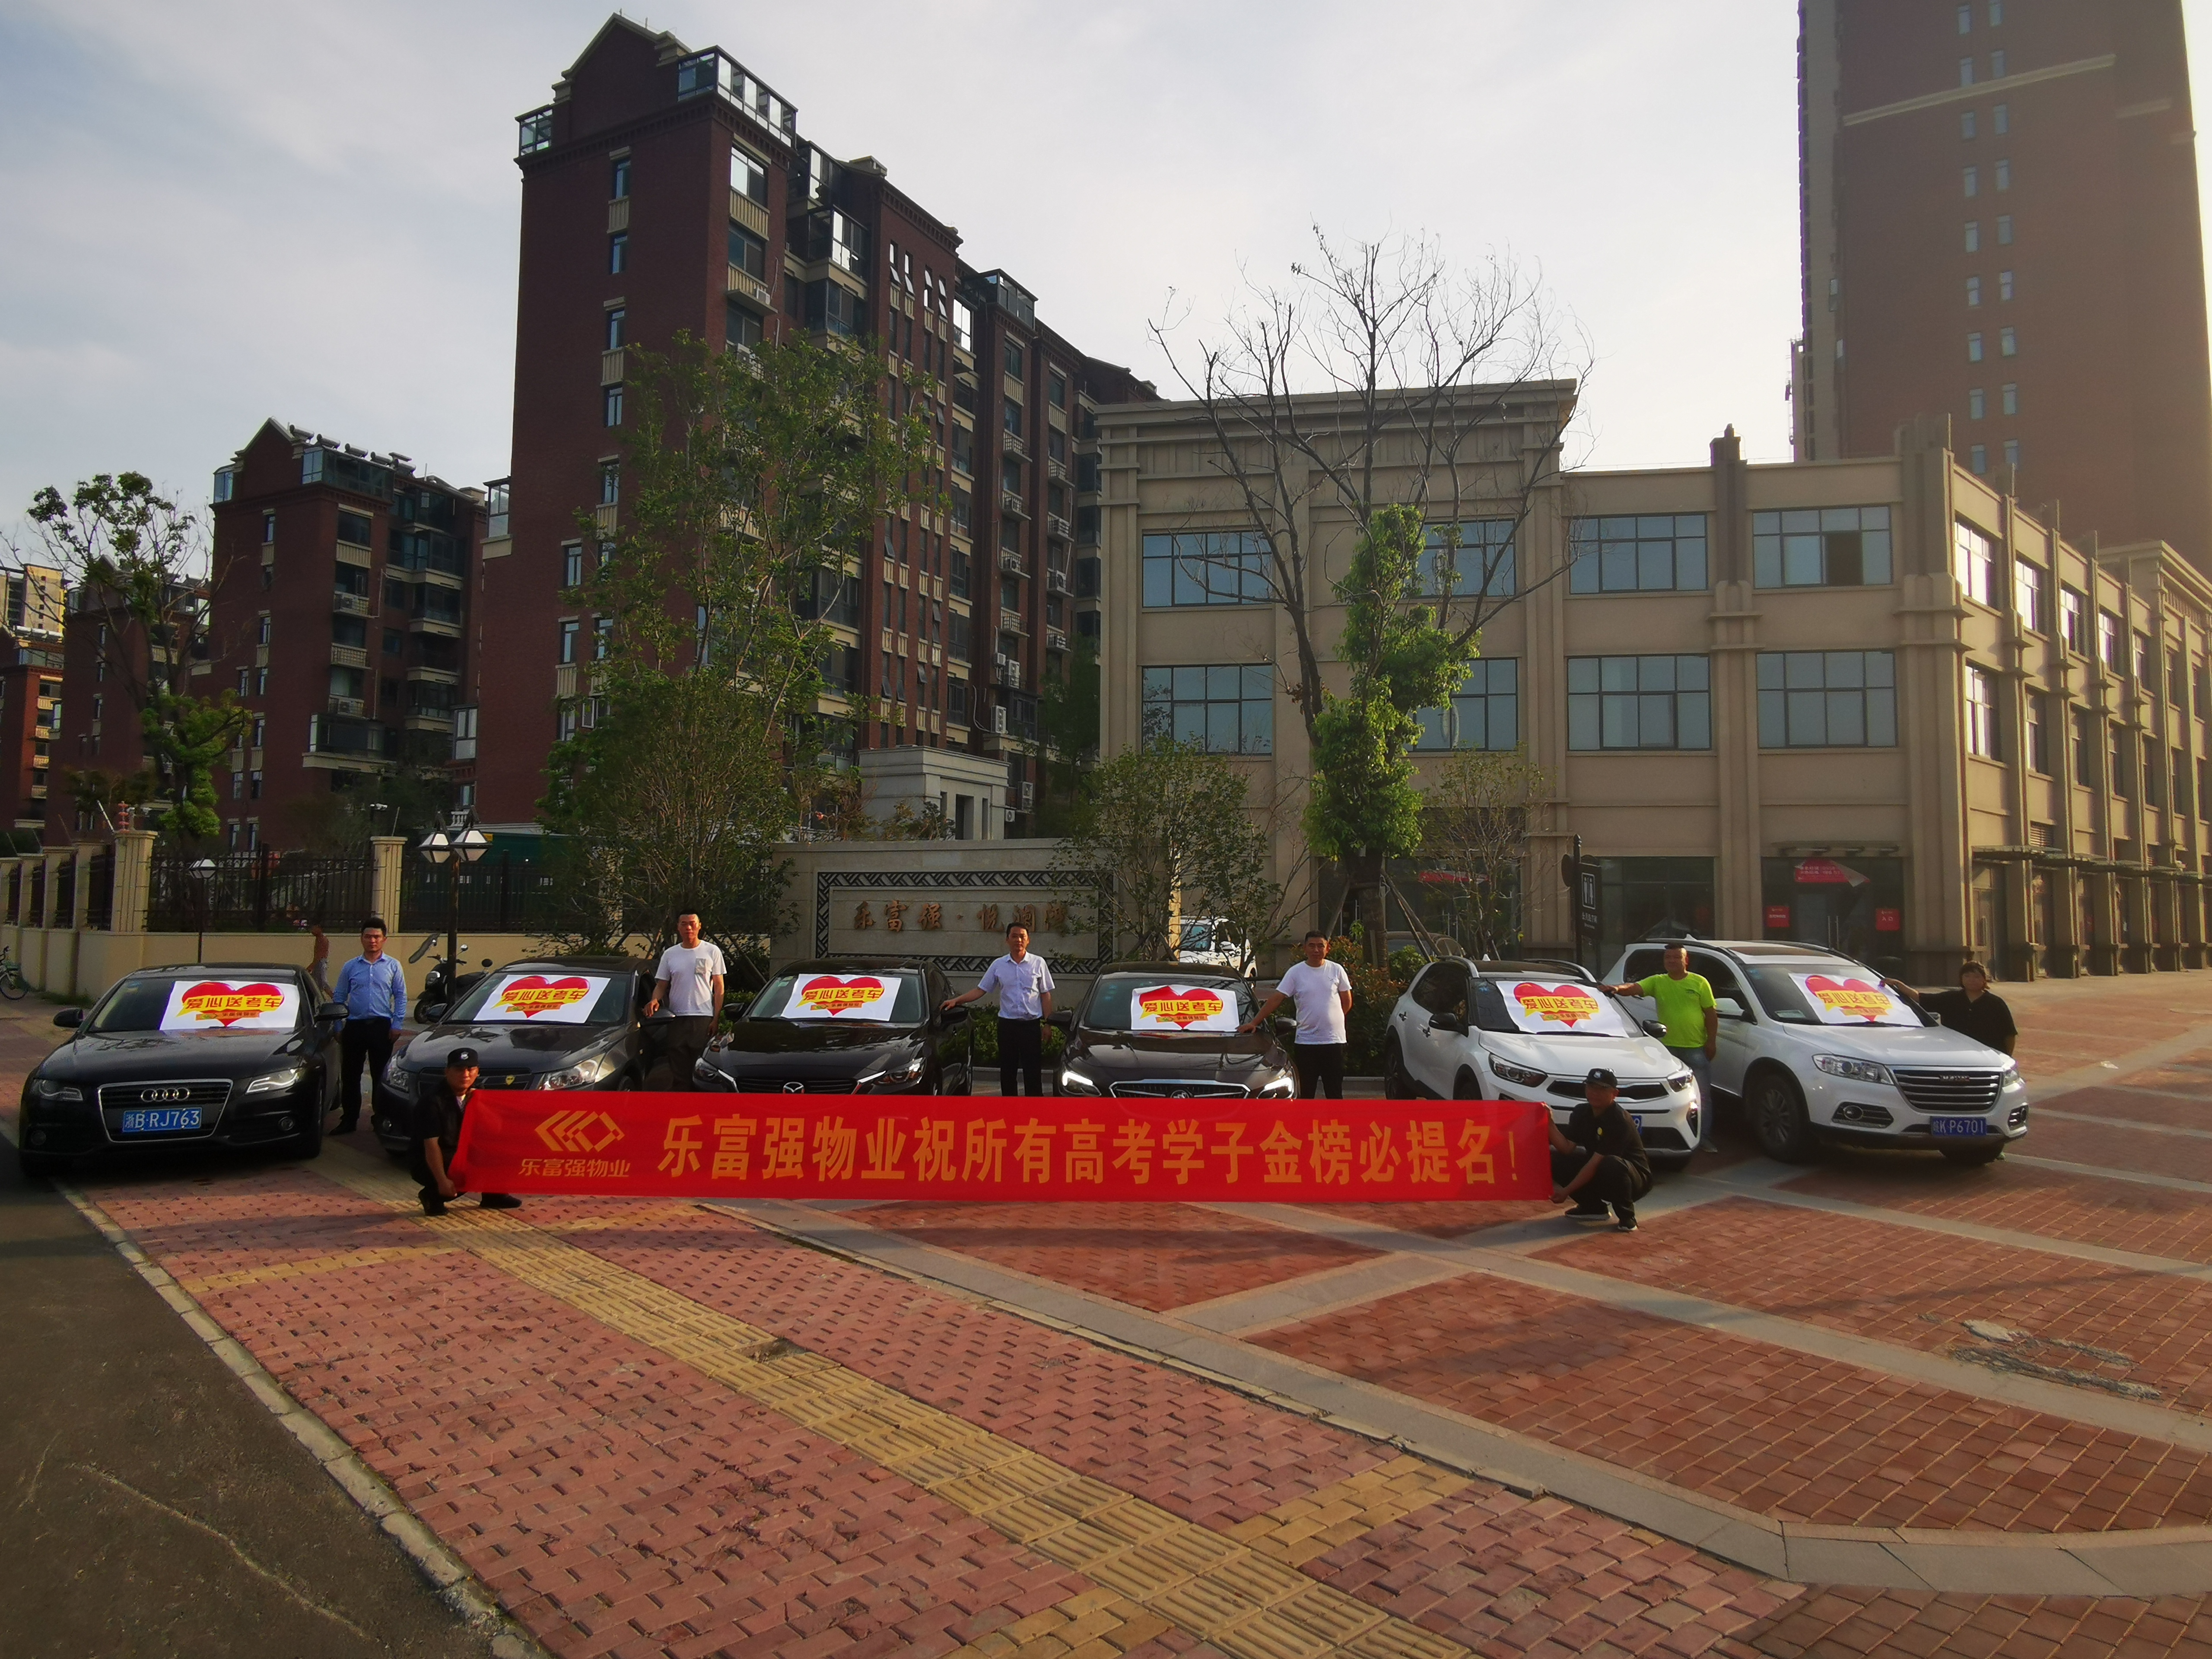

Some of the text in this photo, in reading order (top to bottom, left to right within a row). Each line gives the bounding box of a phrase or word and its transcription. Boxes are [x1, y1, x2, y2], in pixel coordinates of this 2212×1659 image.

[502, 990, 586, 1001] 爱心送考车
[803, 989, 881, 1001] 爱心送考车
[1817, 992, 1890, 1005] 爱心送考车
[185, 997, 281, 1009] 爱心送考车
[1144, 1001, 1222, 1012] 爱心送考车
[1522, 998, 1598, 1010] 爱心送考车
[658, 1113, 1517, 1185] 乐富强物业祝所有高考学子金榜必提名!
[519, 1158, 630, 1177] 乐富强物业
